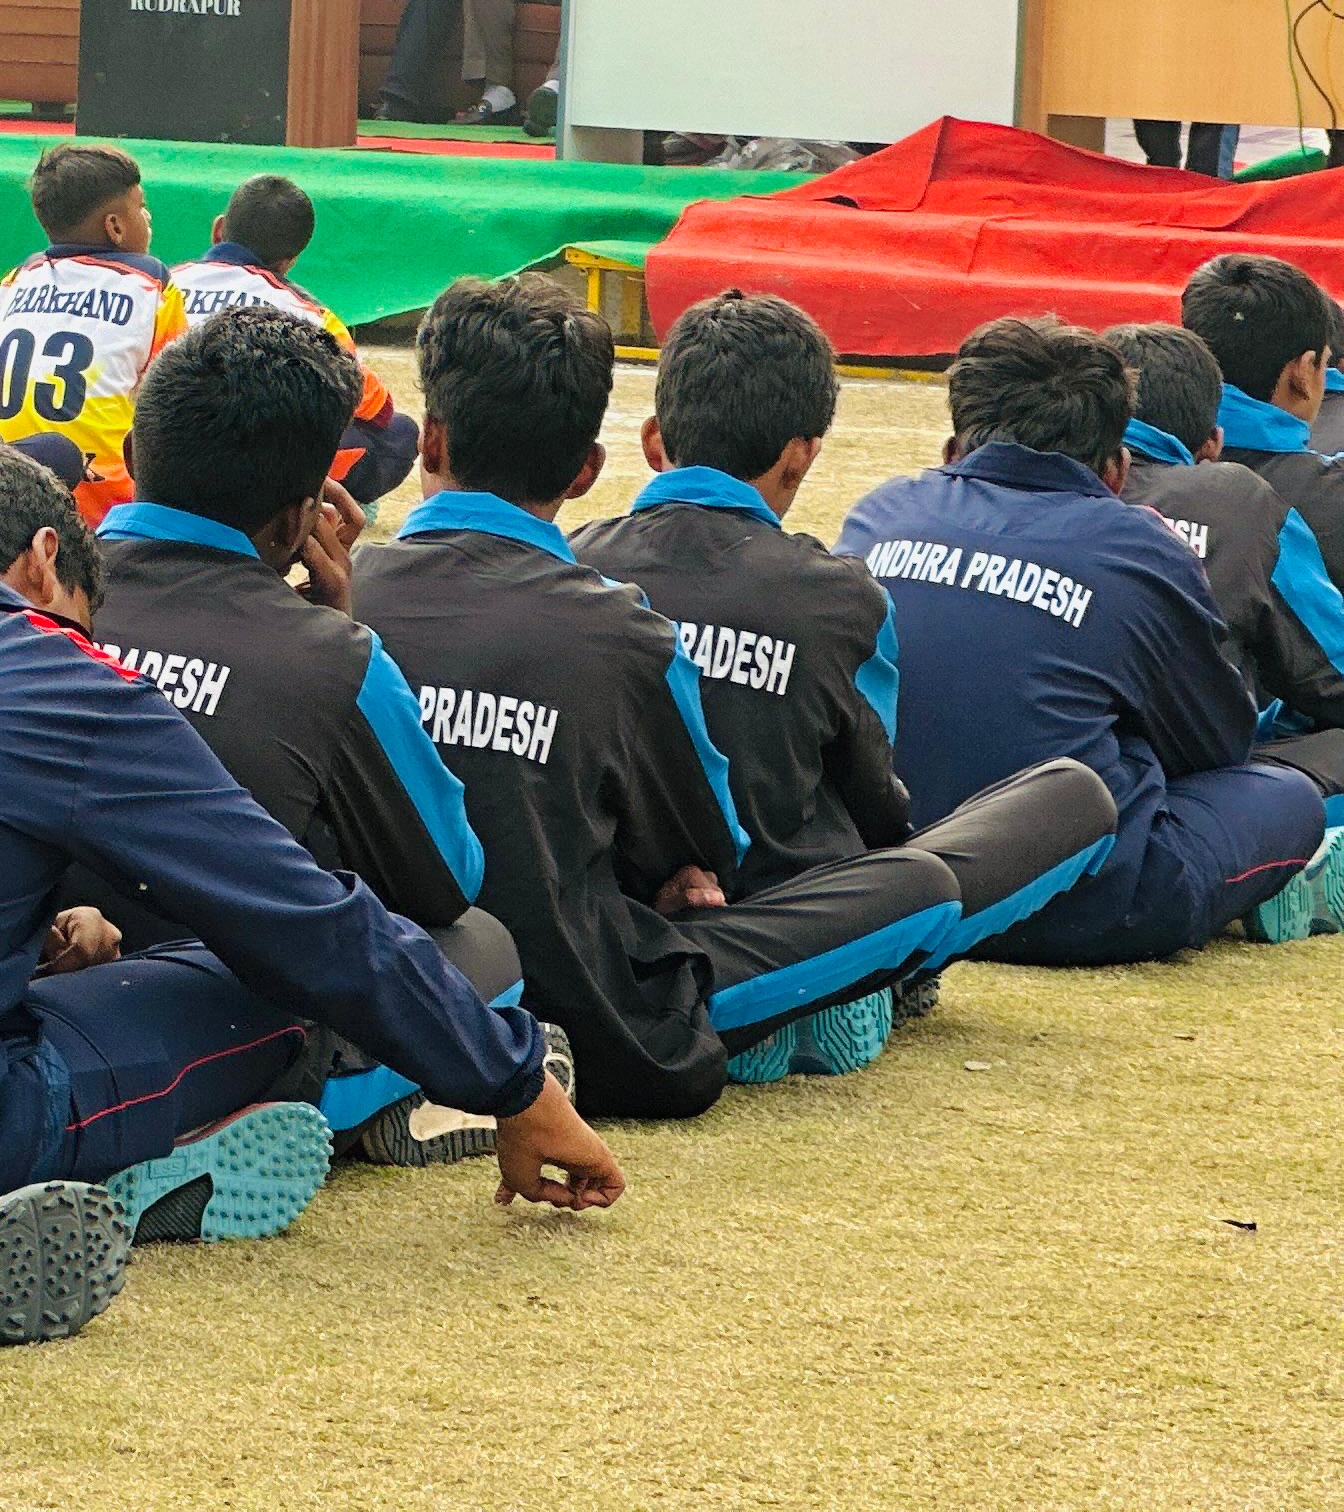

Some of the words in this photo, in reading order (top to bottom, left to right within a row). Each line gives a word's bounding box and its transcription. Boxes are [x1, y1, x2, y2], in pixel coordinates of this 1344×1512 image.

[865, 539, 964, 586] ANDHRA
[960, 551, 1093, 628] PRADESH
[418, 685, 558, 764] PRADESH
